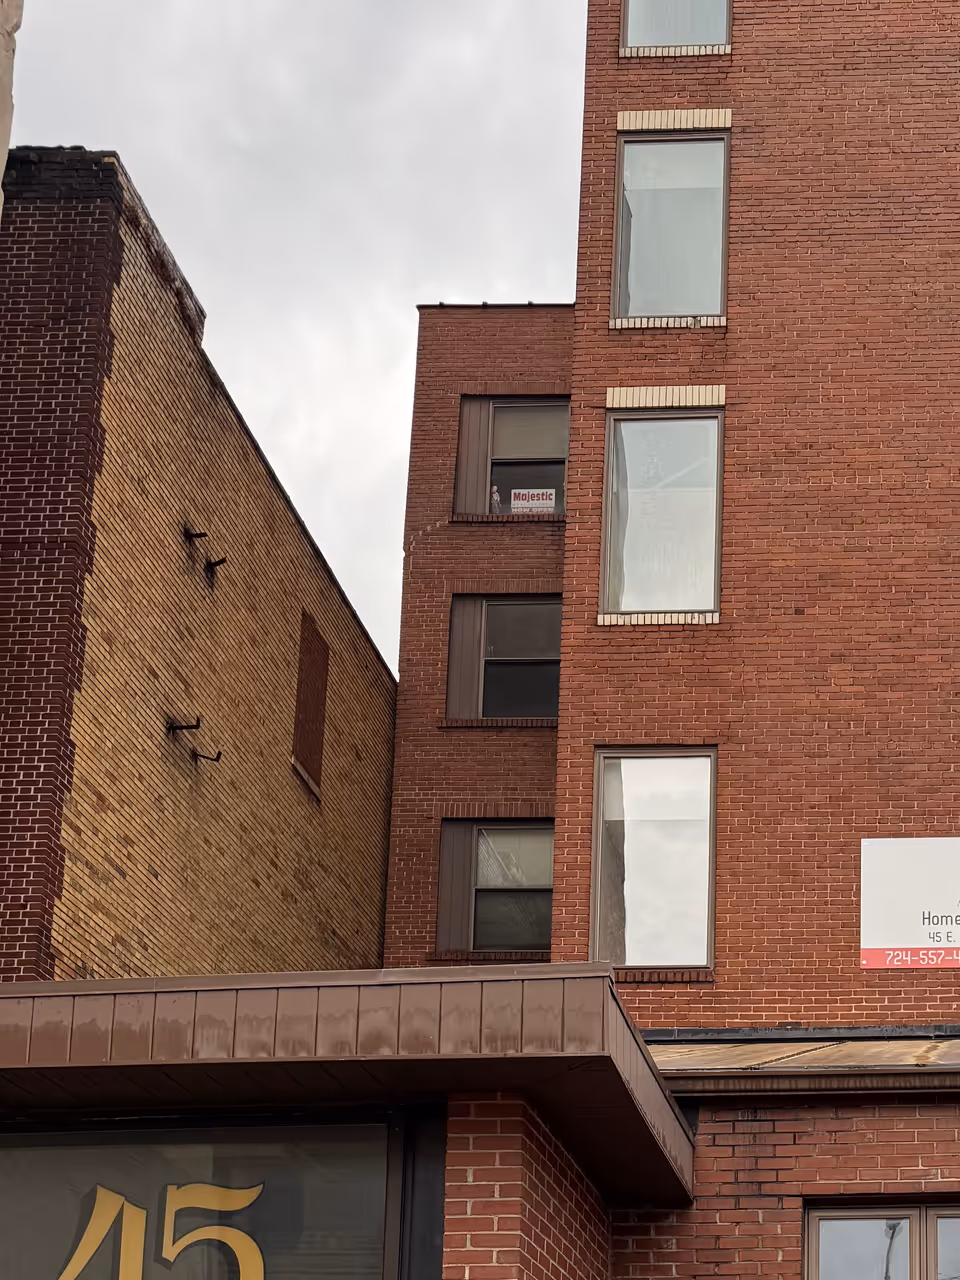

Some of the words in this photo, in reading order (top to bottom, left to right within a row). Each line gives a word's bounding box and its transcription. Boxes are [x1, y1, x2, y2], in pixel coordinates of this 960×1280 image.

[513, 491, 553, 503] Majestic
[928, 931, 942, 943] 45
[946, 931, 956, 943] E.
